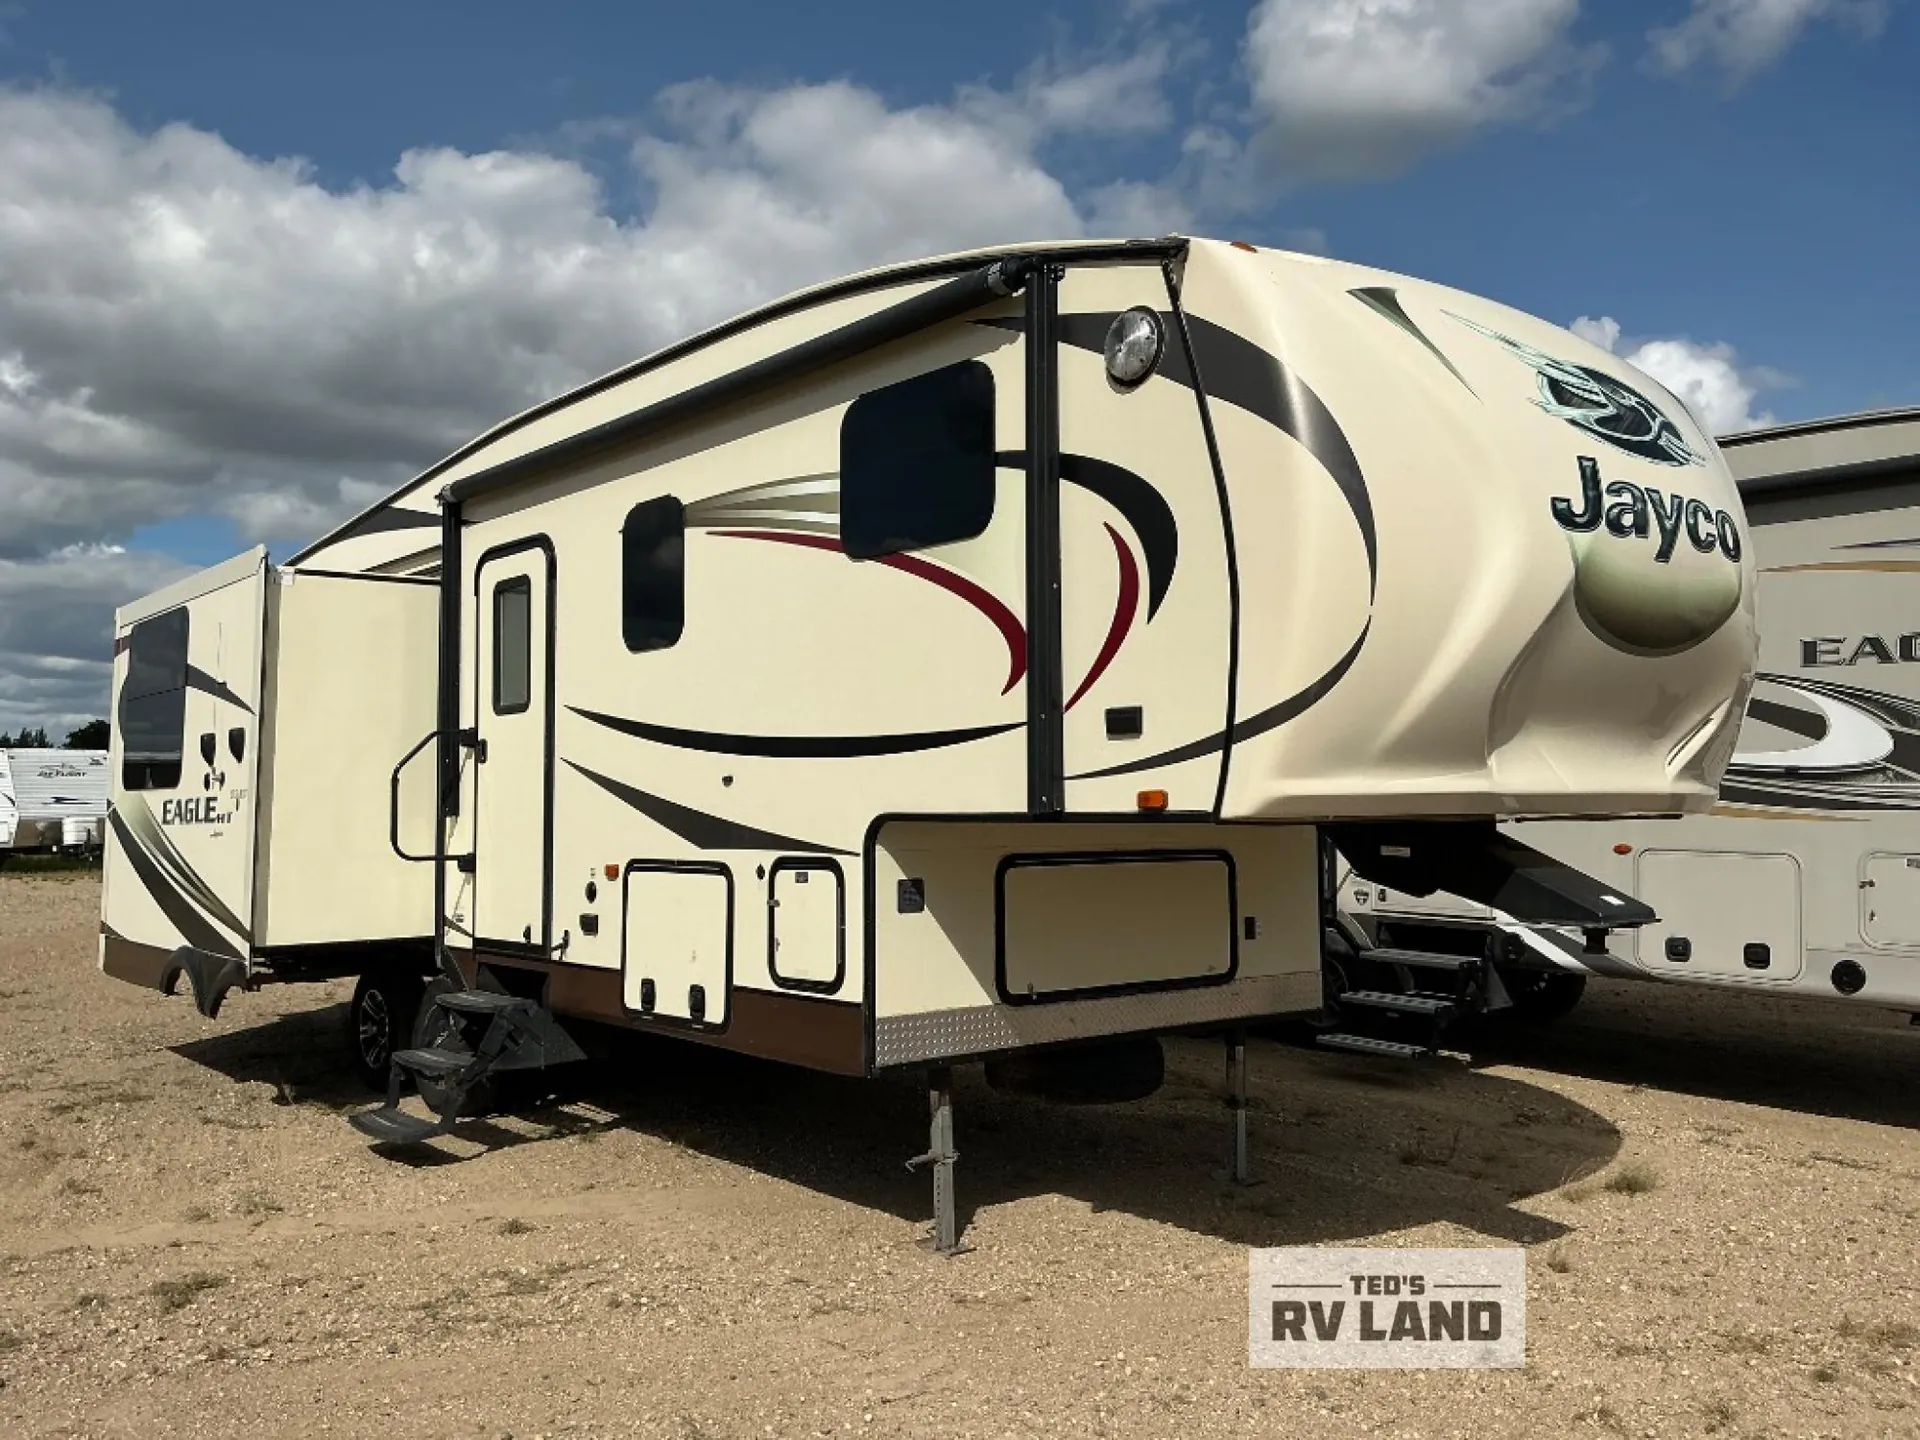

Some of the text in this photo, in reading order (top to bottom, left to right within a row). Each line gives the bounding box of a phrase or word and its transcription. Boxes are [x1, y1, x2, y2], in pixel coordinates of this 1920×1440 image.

[1550, 455, 1742, 564] Jayco
[162, 796, 233, 825] EAGLE HT
